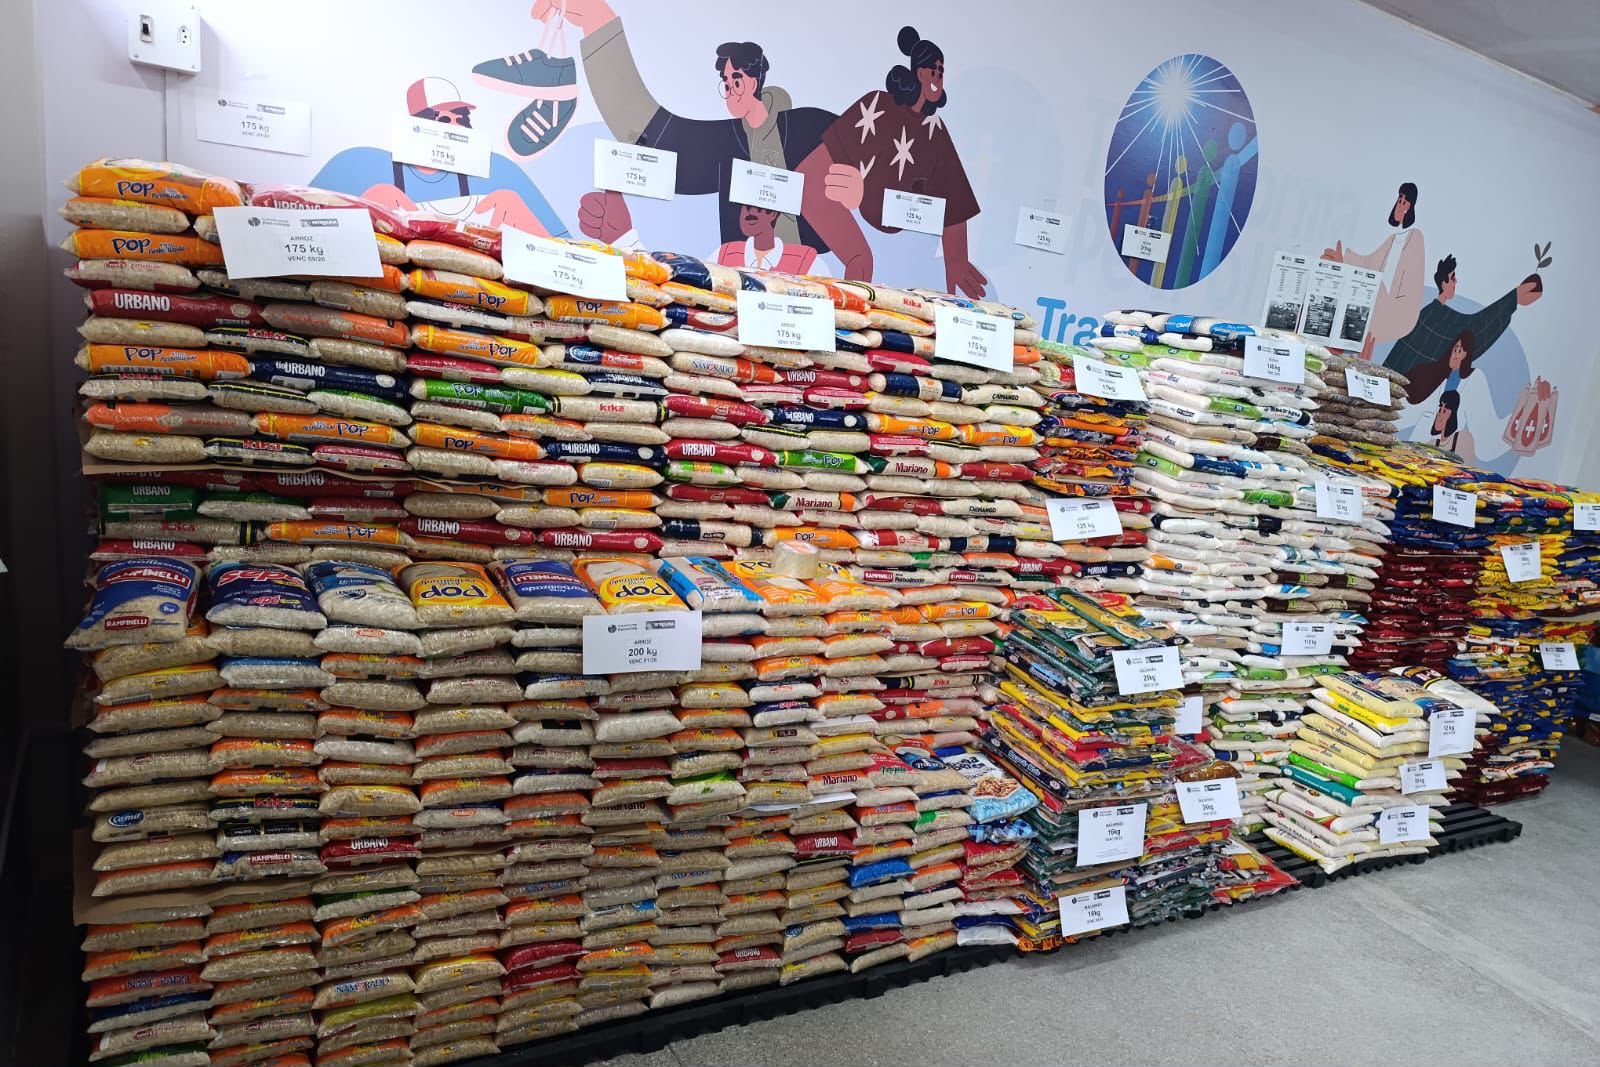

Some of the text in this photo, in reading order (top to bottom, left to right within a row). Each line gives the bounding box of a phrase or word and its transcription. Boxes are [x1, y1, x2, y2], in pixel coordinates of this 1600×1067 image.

[242, 121, 270, 133] 175 kg
[431, 149, 456, 163] 175 kg
[626, 172, 647, 183] 175 kg
[284, 244, 324, 256] 175 kg
[552, 269, 571, 280] 175
[114, 293, 171, 312] URBANO
[777, 330, 801, 340] 175 kg
[967, 341, 988, 353] 175 kg
[787, 370, 816, 383] URBANO
[681, 443, 716, 457] URBANO
[895, 462, 929, 474] Mariano
[133, 485, 171, 497] URBANO
[795, 496, 833, 508] Mariano
[417, 517, 460, 535] URBANO
[554, 533, 593, 547] URBANO
[865, 571, 894, 581] RAMPINELLI
[615, 581, 673, 598] POP
[106, 617, 151, 630] RAMPINELLI
[628, 647, 658, 657] 200 kg
[822, 773, 859, 786] Mariano
[814, 836, 839, 848] URBANO
